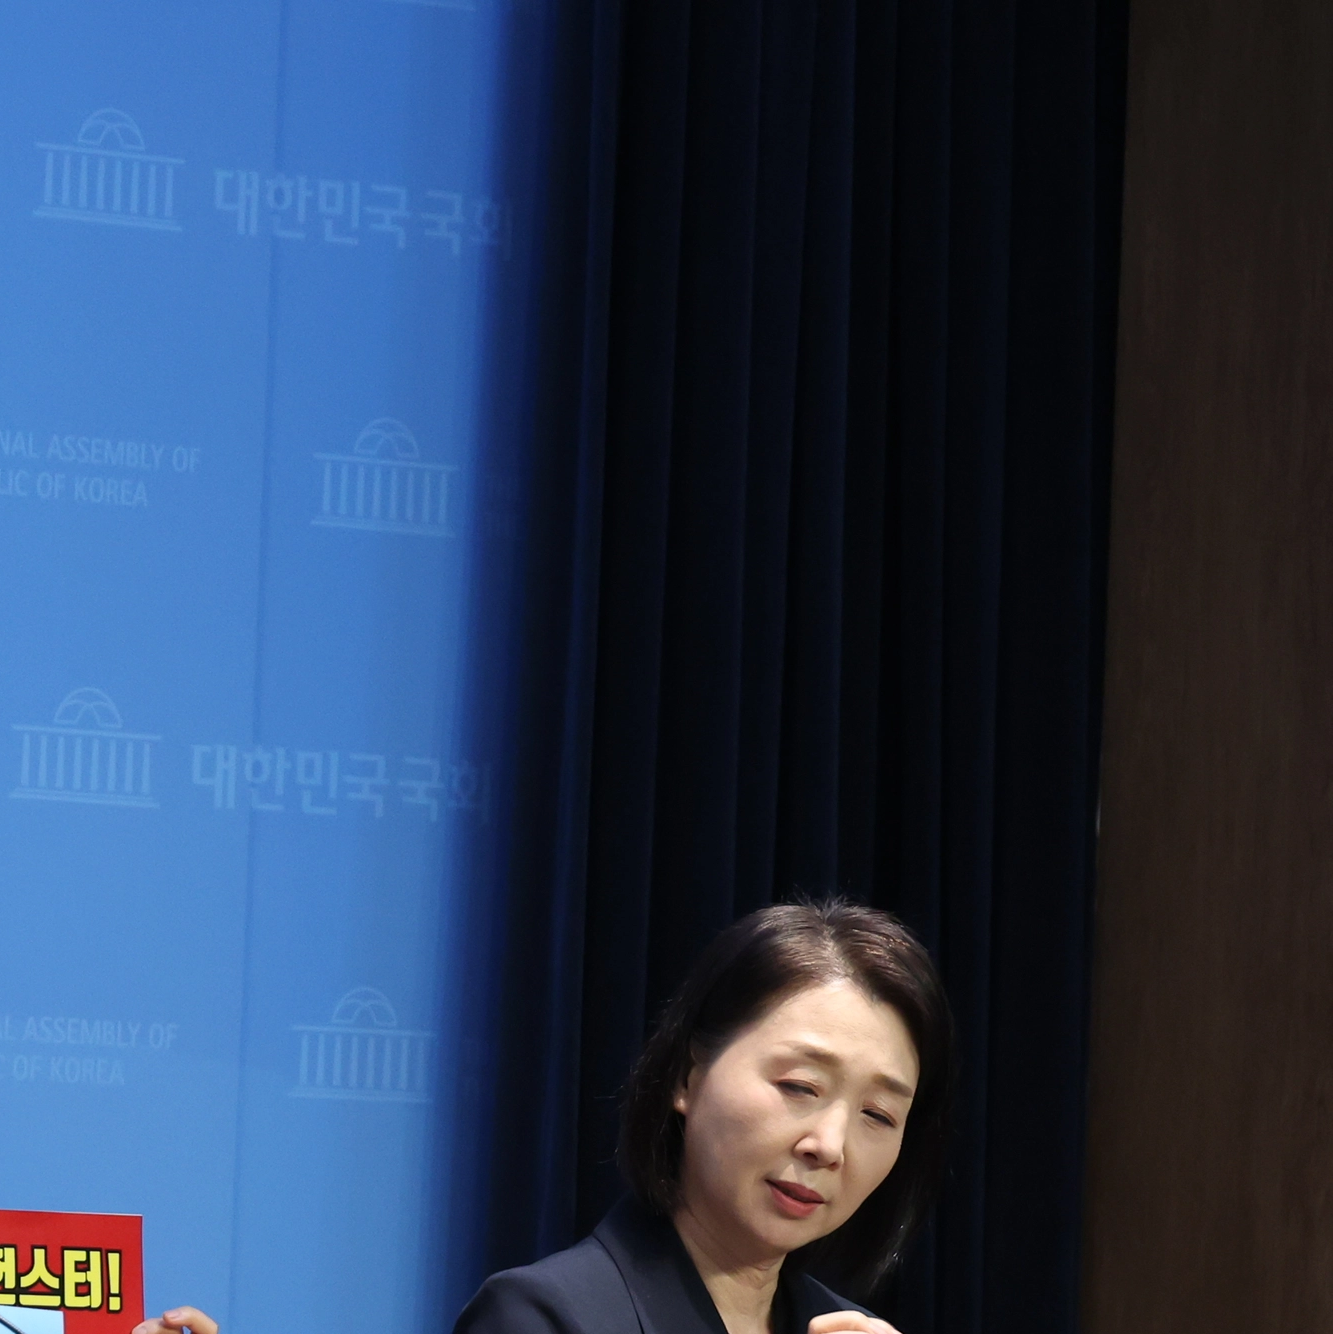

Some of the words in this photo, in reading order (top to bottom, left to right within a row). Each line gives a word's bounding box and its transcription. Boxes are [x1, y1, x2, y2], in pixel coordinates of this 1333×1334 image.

[47, 434, 164, 471] ASSEMBLY
[171, 445, 201, 473] OF
[35, 472, 67, 500] OF
[73, 477, 149, 507] KOREA
[22, 1016, 142, 1049] ASSEMBLY
[148, 1022, 181, 1050] OF
[12, 1053, 43, 1082] OF
[49, 1056, 126, 1086] KOREA
